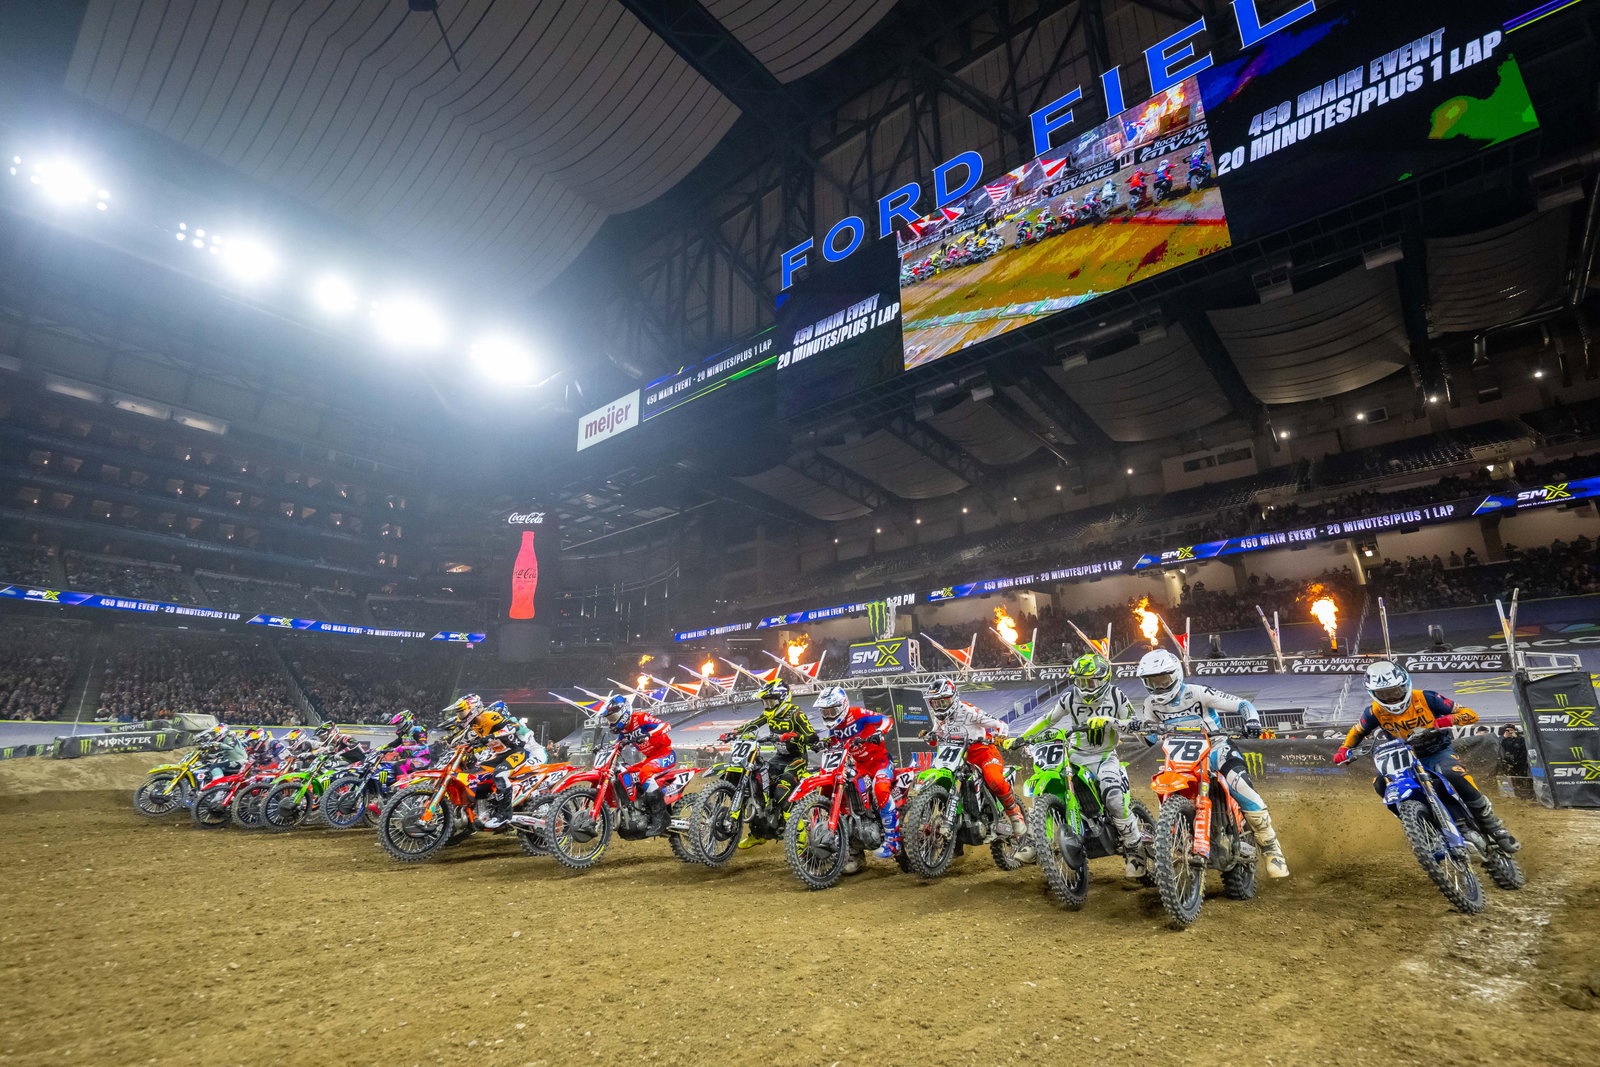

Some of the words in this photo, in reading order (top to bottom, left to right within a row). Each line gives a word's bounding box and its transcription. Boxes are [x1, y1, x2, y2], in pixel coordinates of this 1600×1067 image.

[1248, 100, 1292, 137] 450
[1297, 65, 1364, 119] MAIN
[1370, 27, 1446, 84] EVENT
[1218, 146, 1245, 176] 20
[1250, 69, 1424, 163] MINUTES/PLUS
[1429, 55, 1442, 82] 1
[1449, 29, 1503, 75] LAP
[780, 150, 984, 292] FORD
[793, 326, 812, 346] 450
[814, 314, 845, 338] MAIN
[847, 293, 881, 325] EVENT
[777, 352, 791, 371] 20
[792, 318, 867, 365] MINUTES/PLUS
[869, 312, 876, 330] 1
[877, 301, 901, 327] LAP
[646, 394, 658, 406] 450
[659, 387, 674, 401] MAIN
[674, 377, 692, 393] EVENT
[697, 371, 706, 383] 20
[706, 350, 753, 379] MINUTES/PLUS
[759, 338, 773, 354] LAP
[584, 402, 632, 440] meijer
[1517, 483, 1572, 501] SMX
[1240, 538, 1259, 549] 450
[1260, 532, 1286, 546] MAIN
[1288, 527, 1317, 543] EVENT
[1327, 523, 1341, 535] 20
[1343, 509, 1422, 533] MINUTES/PLUS
[1424, 507, 1431, 520] 1
[1432, 504, 1455, 518] LAP
[1161, 546, 1194, 560] SMX
[984, 579, 996, 591] 450
[997, 577, 1014, 589] MAIN
[1015, 573, 1035, 587] EVENT
[1041, 571, 1050, 582] 20
[1051, 563, 1102, 581] MINUTES/PLUS
[1108, 559, 1123, 571] LAP
[26, 590, 60, 601] SMX
[903, 593, 916, 605] PM
[930, 587, 953, 598] SMX
[100, 598, 115, 607] 450
[116, 600, 137, 609] MAIN
[138, 602, 159, 612] EVENT
[165, 605, 175, 613] 20
[176, 607, 223, 619] MINUTES/PLUS
[228, 612, 241, 620] LAP
[808, 611, 817, 619] 450
[817, 609, 830, 618] MAIN
[830, 607, 844, 616] EVENT
[320, 623, 332, 631] 450
[332, 624, 347, 632] MAIN
[347, 626, 363, 634] EVENT
[851, 643, 903, 667] SMX
[1230, 659, 1268, 667] MOUNTAIN
[1448, 654, 1502, 662] MOUNTAIN
[867, 666, 905, 674] CHAMPIONSHIP
[1077, 707, 1113, 717] FXR
[1538, 710, 1596, 727] SMX
[768, 719, 790, 730] FXR
[834, 723, 858, 739] FXR
[97, 736, 152, 747] MONSTER
[731, 742, 752, 758] 20
[824, 751, 842, 769] 12
[938, 746, 961, 763] 41
[1035, 745, 1063, 768] 36
[1168, 741, 1203, 762] 78
[1281, 754, 1326, 762] MONSTER
[1376, 748, 1412, 776] 711
[678, 772, 690, 784] 17
[899, 773, 911, 786] 12
[1553, 763, 1600, 780] SMX
